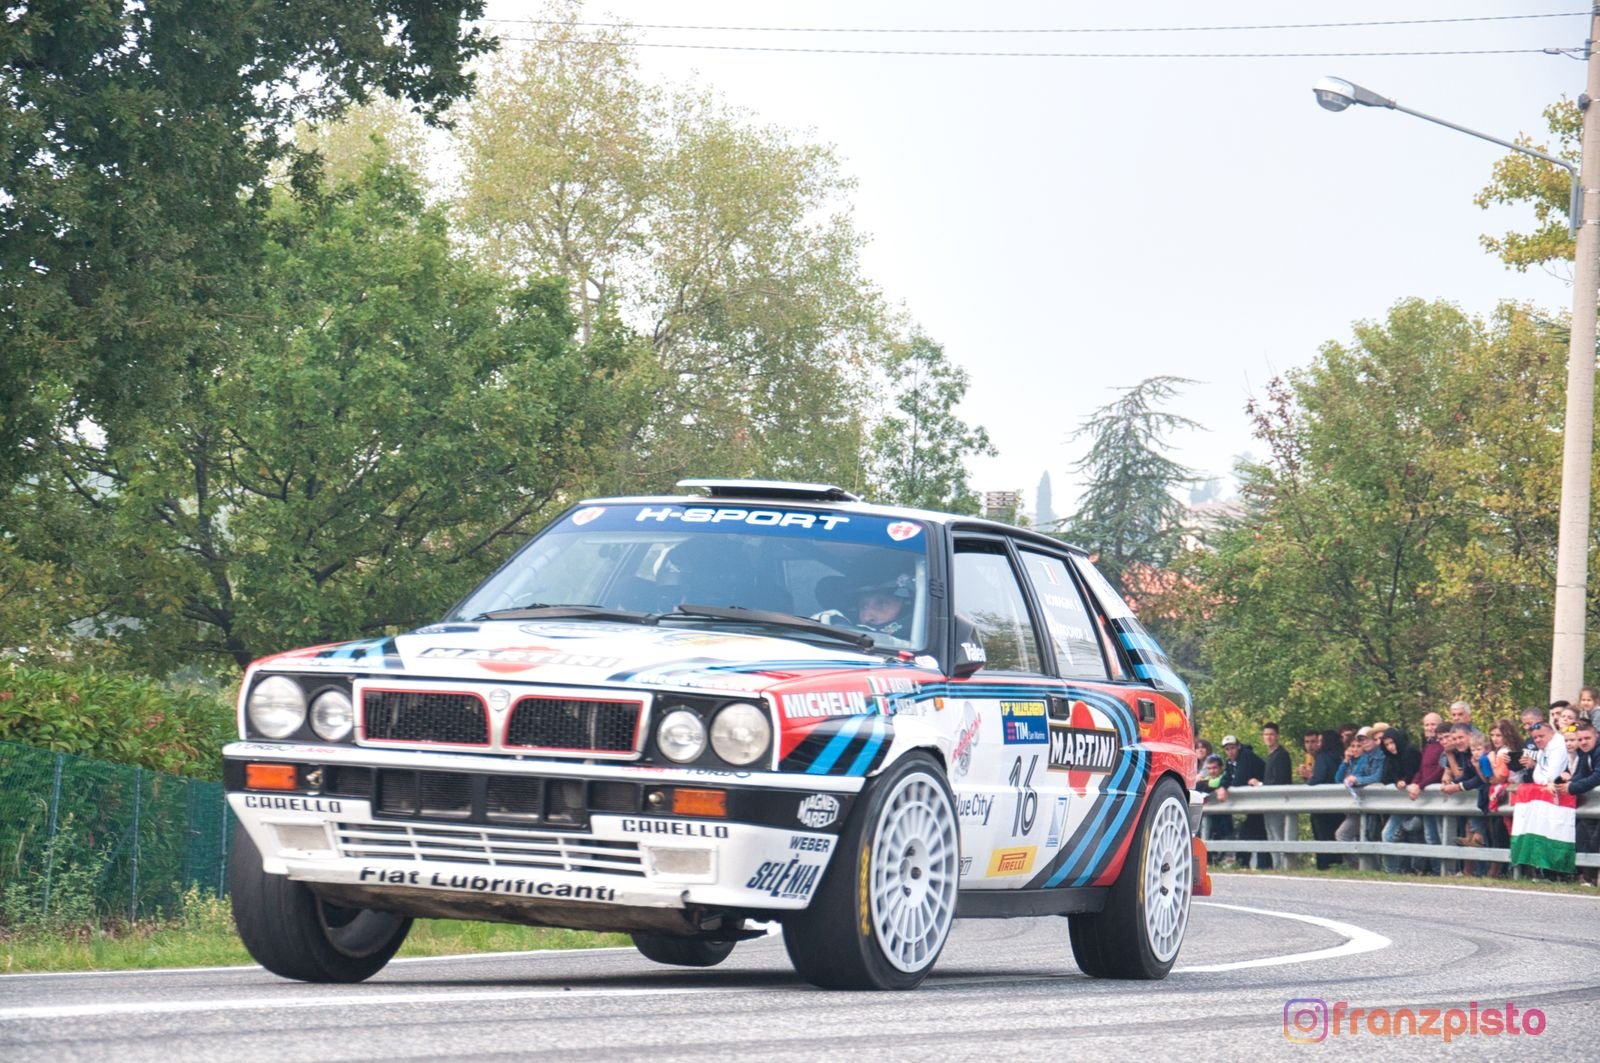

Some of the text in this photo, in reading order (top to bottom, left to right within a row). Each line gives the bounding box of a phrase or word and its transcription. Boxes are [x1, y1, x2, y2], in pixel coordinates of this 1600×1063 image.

[635, 507, 850, 531] H-SPORT
[781, 691, 867, 718] MICHELIN
[1015, 722, 1029, 740] TIM
[1050, 731, 1115, 768] MARTINI
[972, 793, 995, 826] City
[1009, 754, 1039, 837] 16
[790, 836, 831, 852] WEBER
[997, 852, 1027, 872] PIRELLI
[359, 866, 615, 901] Fiat Lubrificanti
[746, 859, 821, 897] SELENIA
